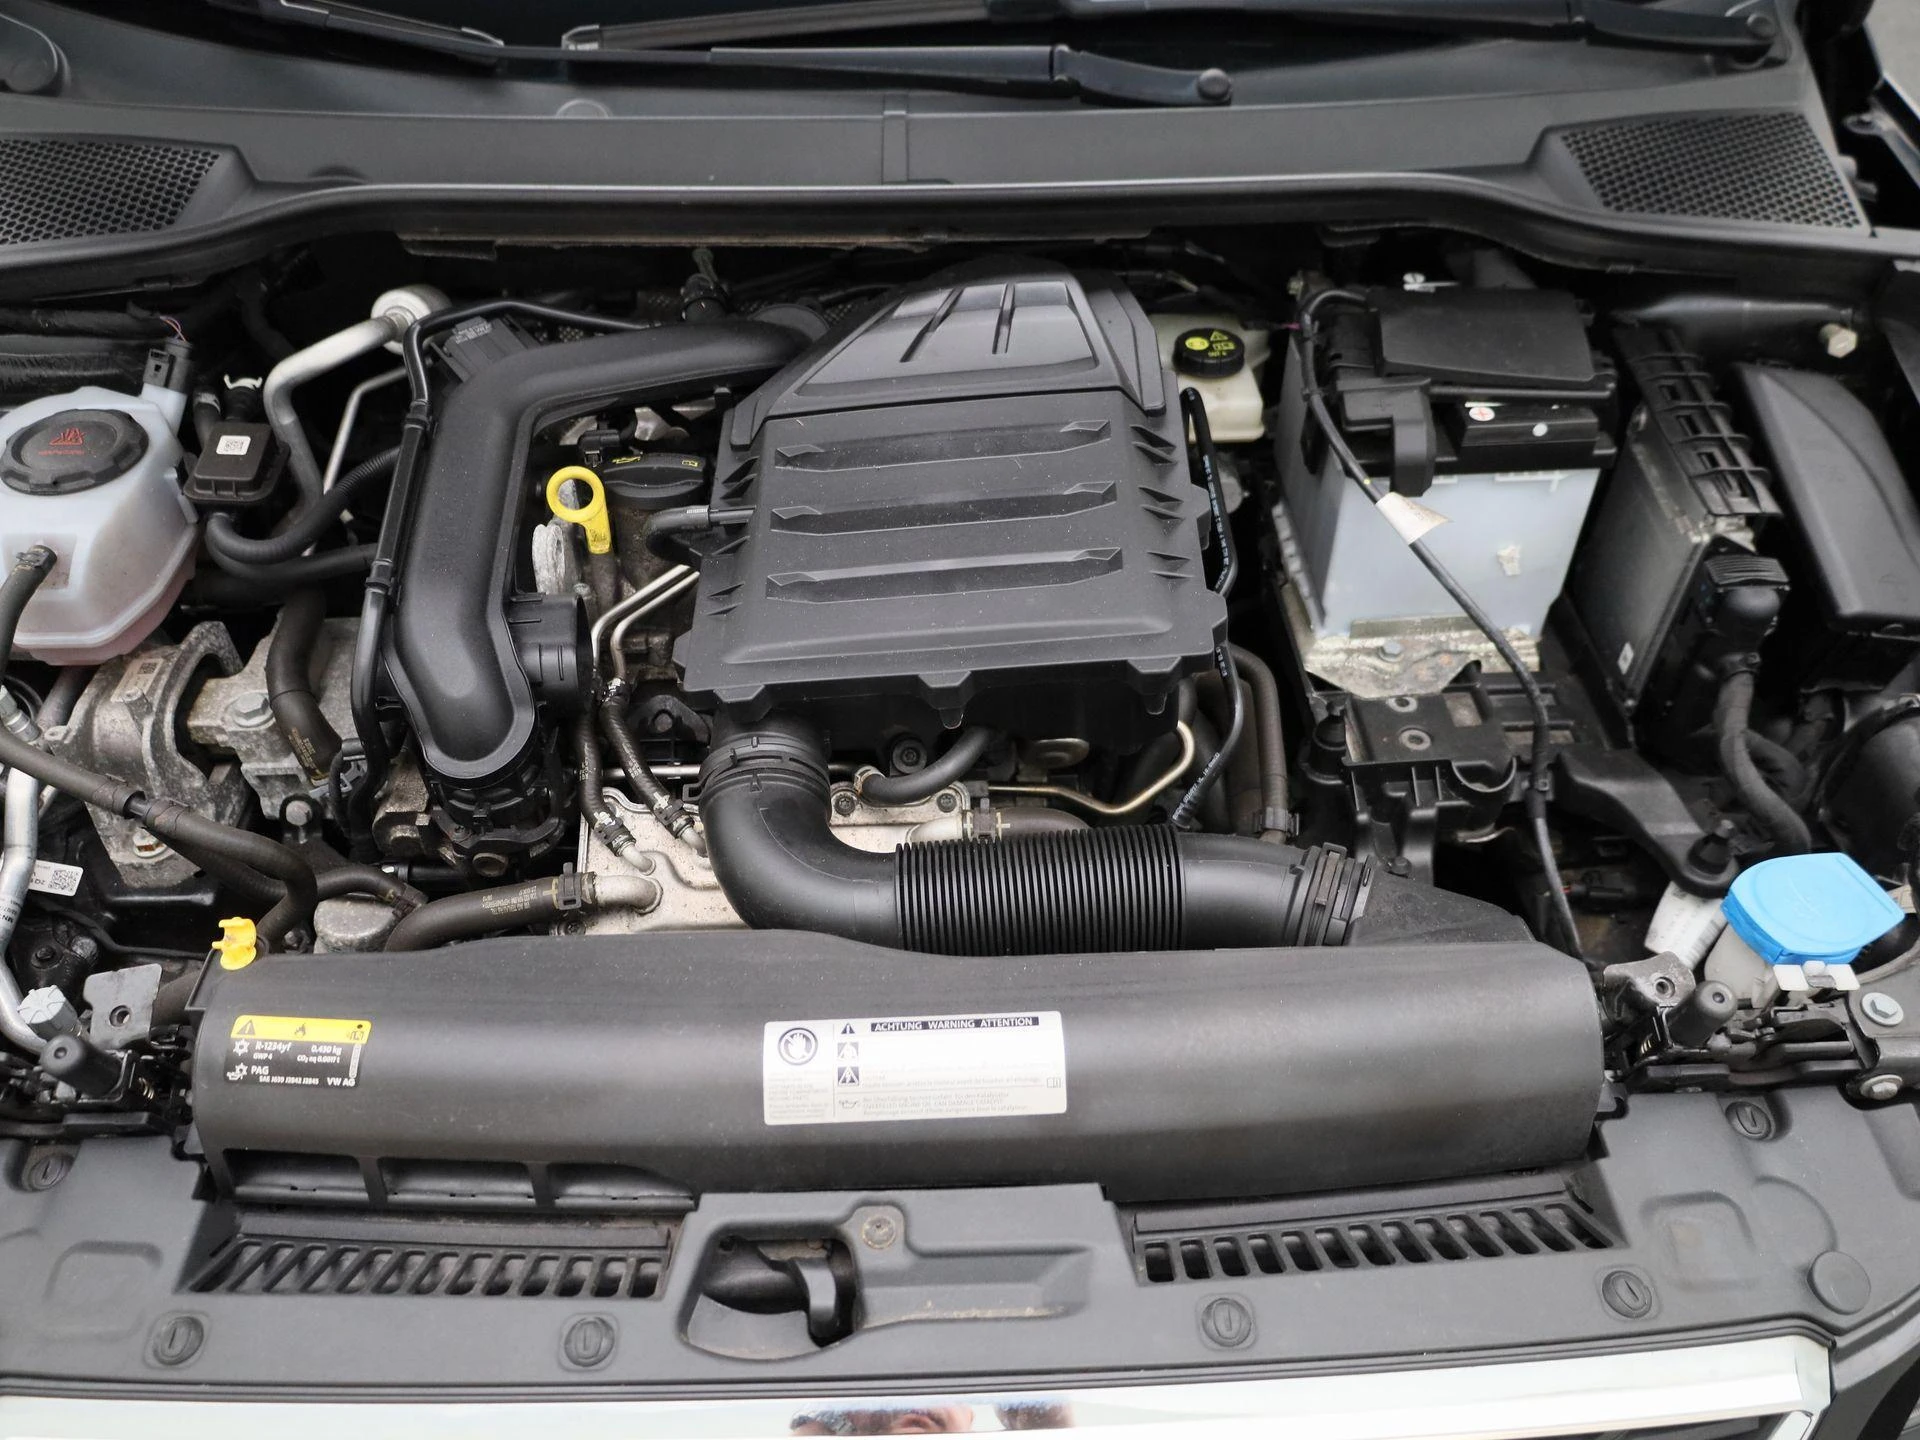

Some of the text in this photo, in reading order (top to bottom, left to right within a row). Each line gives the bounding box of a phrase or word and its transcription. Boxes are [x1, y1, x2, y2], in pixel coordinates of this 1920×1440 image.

[875, 1017, 1033, 1031] ACHTUNG WARNING ATTENTION
[255, 1041, 292, 1054] R-1234yf
[251, 1065, 269, 1075] PAG
[259, 1075, 270, 1083] SAE
[327, 1077, 342, 1086] VW
[342, 1077, 356, 1087] AG
